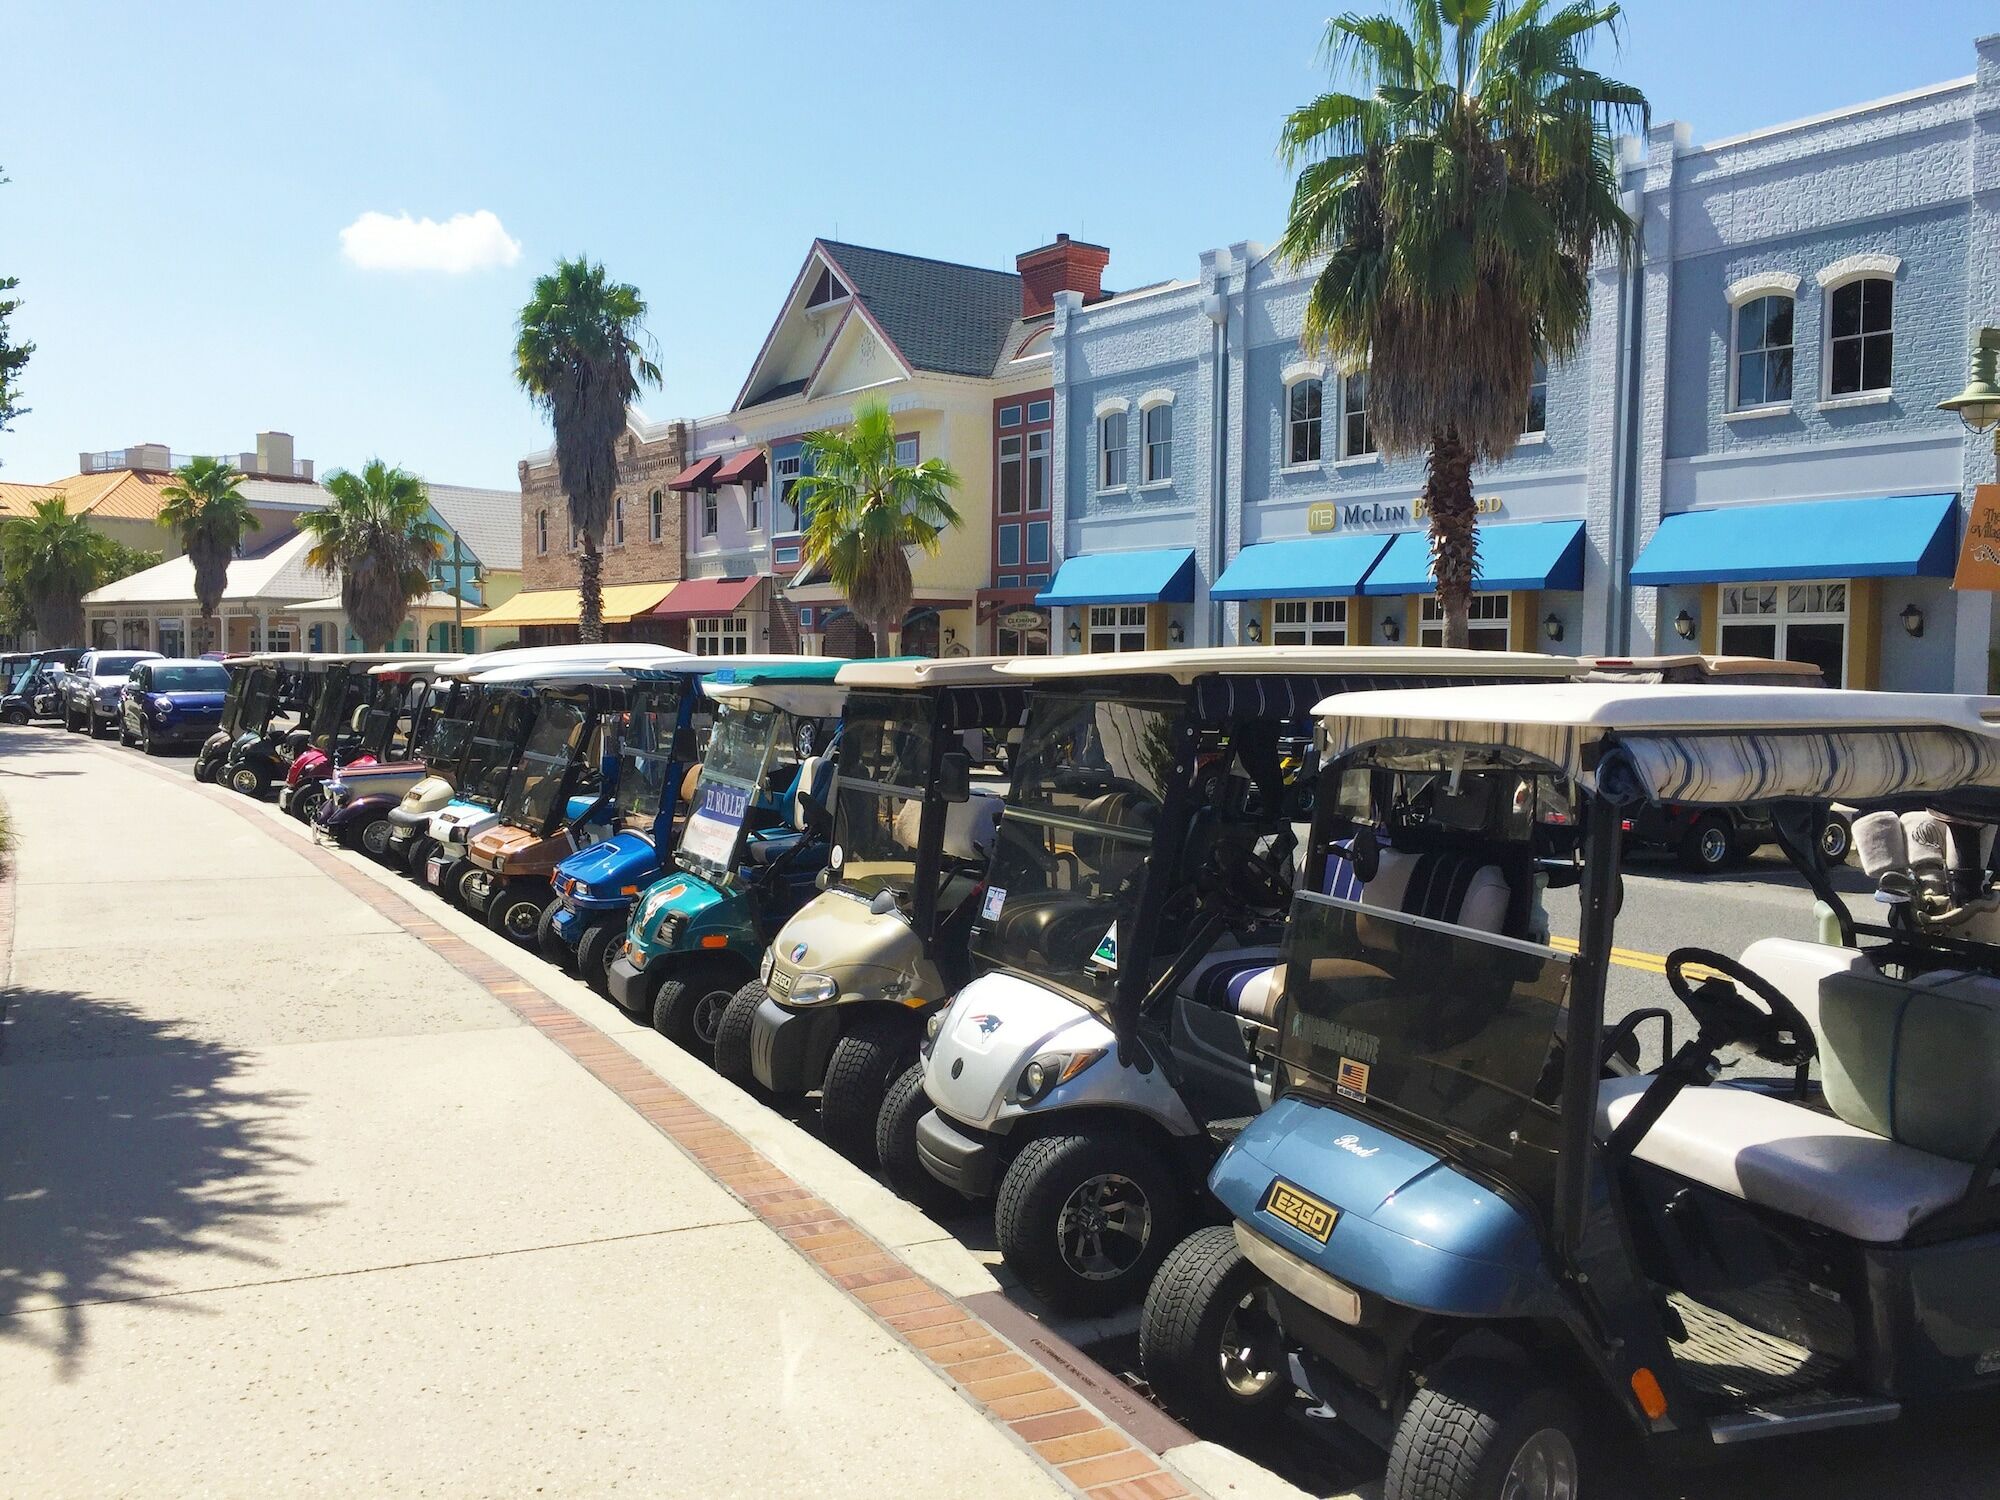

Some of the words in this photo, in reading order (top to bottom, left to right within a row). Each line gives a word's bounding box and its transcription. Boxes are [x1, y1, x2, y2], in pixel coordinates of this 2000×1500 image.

[705, 790, 715, 811] EL
[715, 792, 747, 818] ROLLER
[1276, 1191, 1327, 1232] EZGO
